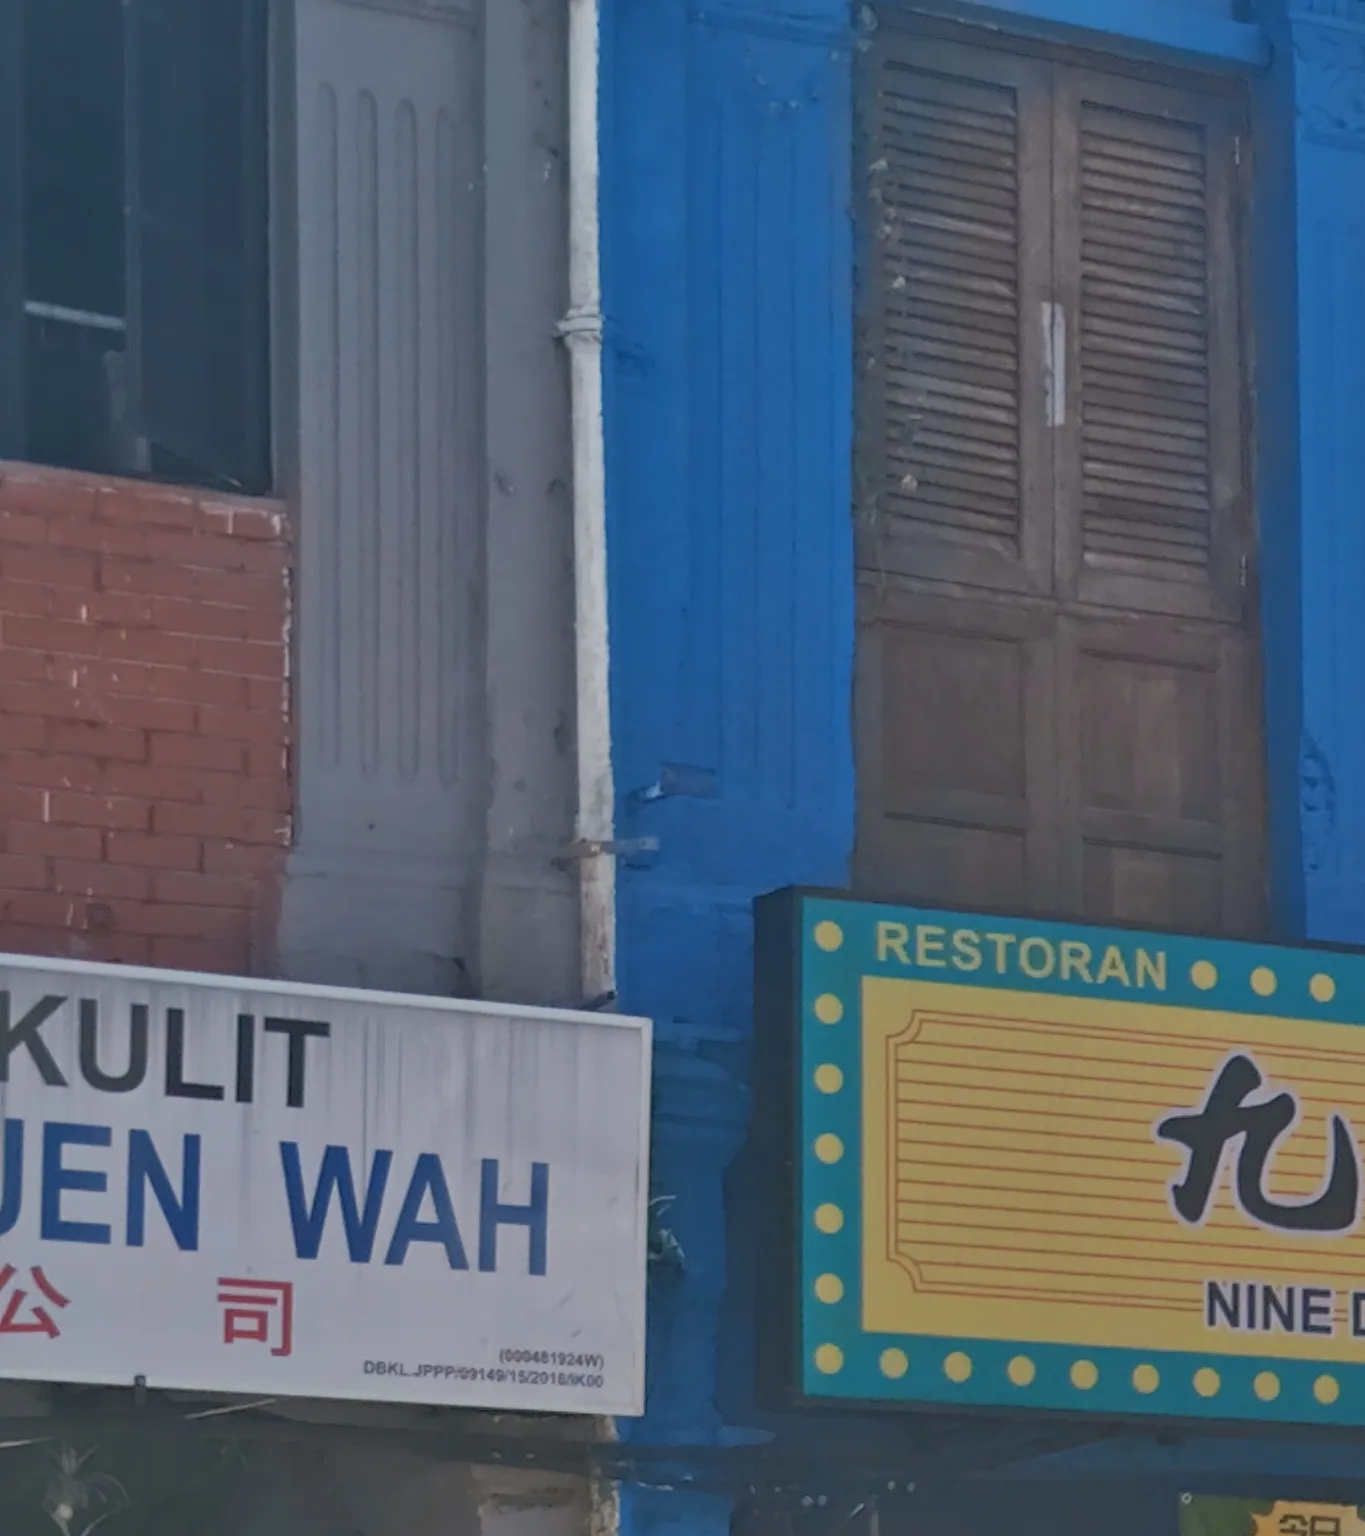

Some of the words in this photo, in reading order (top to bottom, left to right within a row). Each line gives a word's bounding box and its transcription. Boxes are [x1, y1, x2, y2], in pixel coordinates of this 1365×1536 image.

[876, 921, 1167, 990] RESTORAN
[0, 989, 330, 1108] KULIT
[279, 1140, 549, 1276] WAH
[1207, 1280, 1332, 1334] NINE
